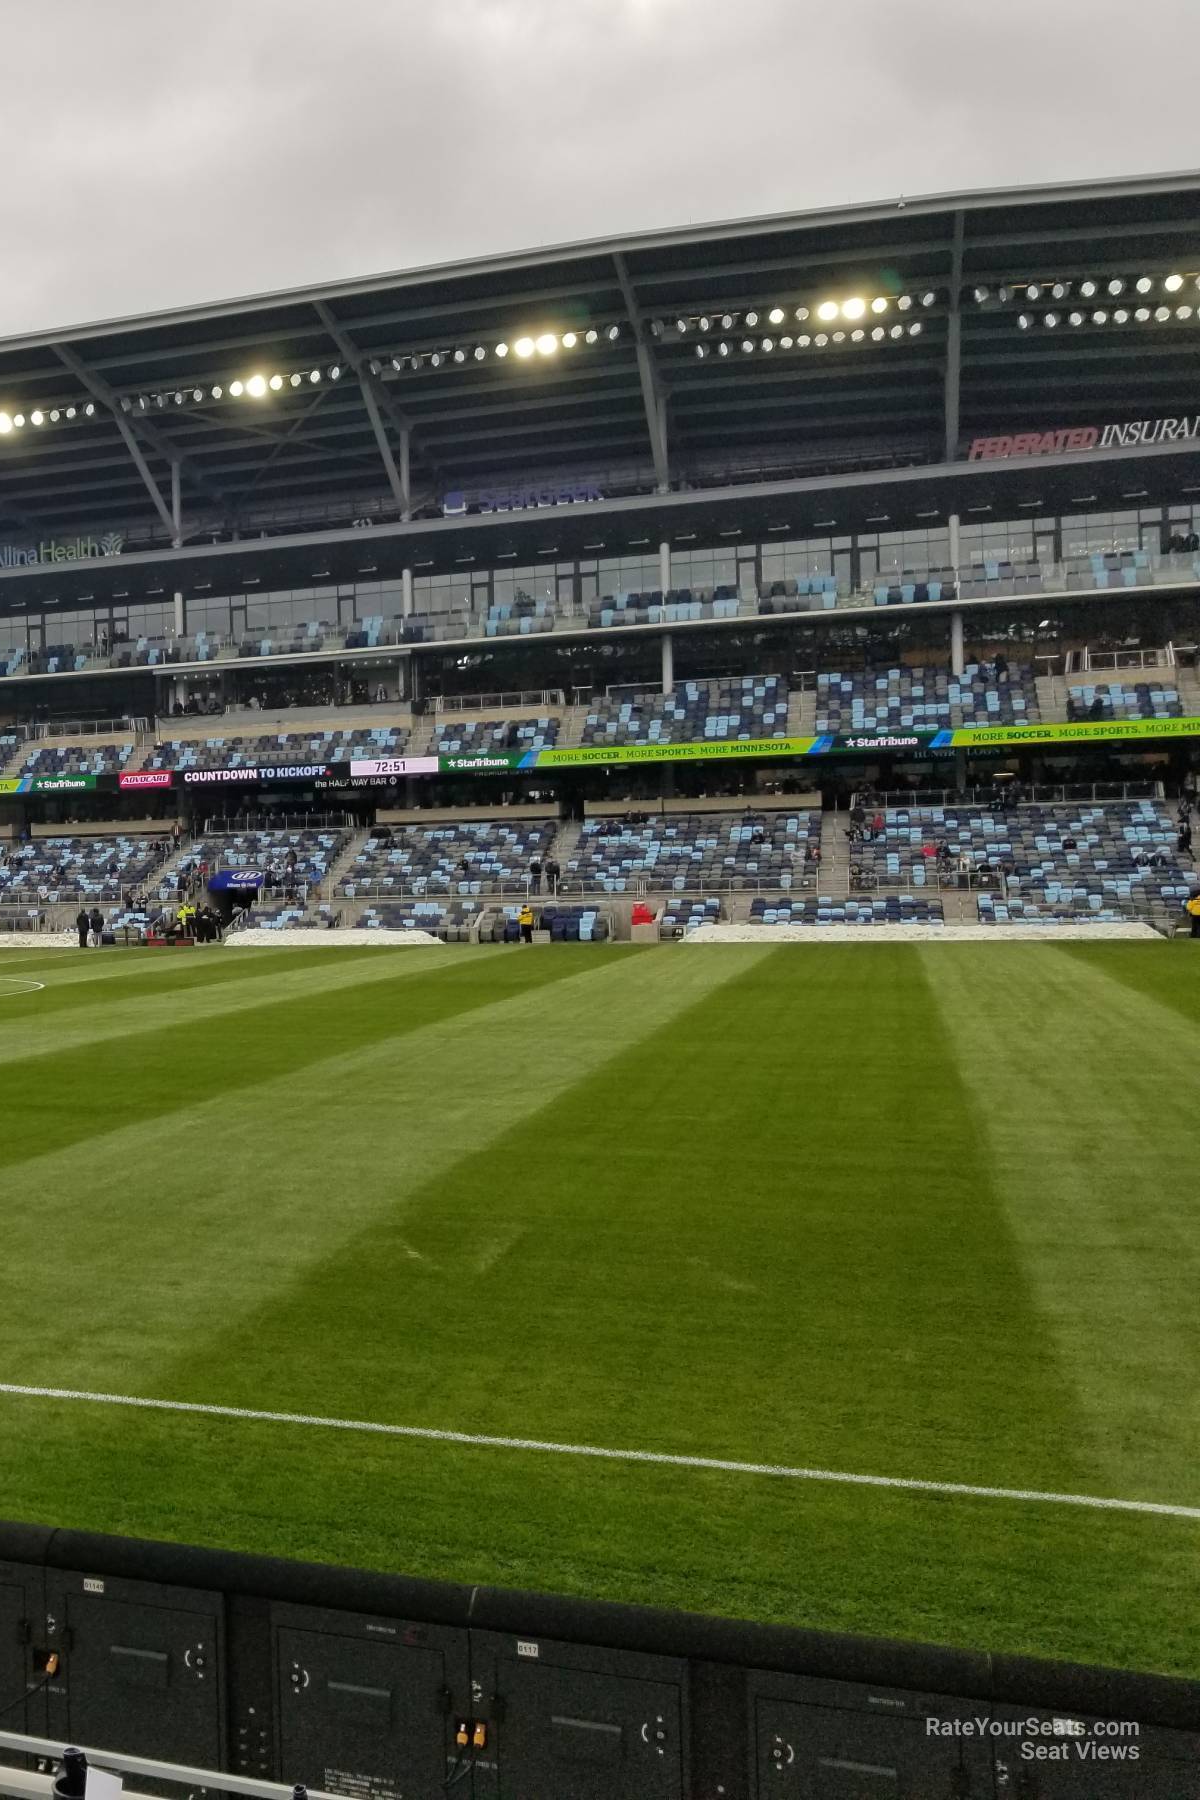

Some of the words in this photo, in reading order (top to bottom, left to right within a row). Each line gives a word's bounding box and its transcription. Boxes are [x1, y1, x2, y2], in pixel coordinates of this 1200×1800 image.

[968, 427, 1098, 461] FEDERATED
[39, 536, 100, 564] Health
[973, 732, 1004, 741] MORE
[1059, 728, 1090, 738] MORE
[857, 736, 918, 747] StarTribune
[553, 753, 580, 762] MORE
[626, 750, 654, 758] MORE
[700, 745, 729, 754] MORE
[375, 761, 406, 772] 72:51
[458, 758, 509, 767] StarTribune
[121, 773, 169, 784] ADVOCARE
[185, 768, 257, 782] COUNTDOWN
[259, 768, 275, 778] TO
[44, 779, 86, 788] StarTribune
[315, 780, 327, 788] the
[351, 778, 369, 787] WAY
[370, 777, 387, 786] BAR
